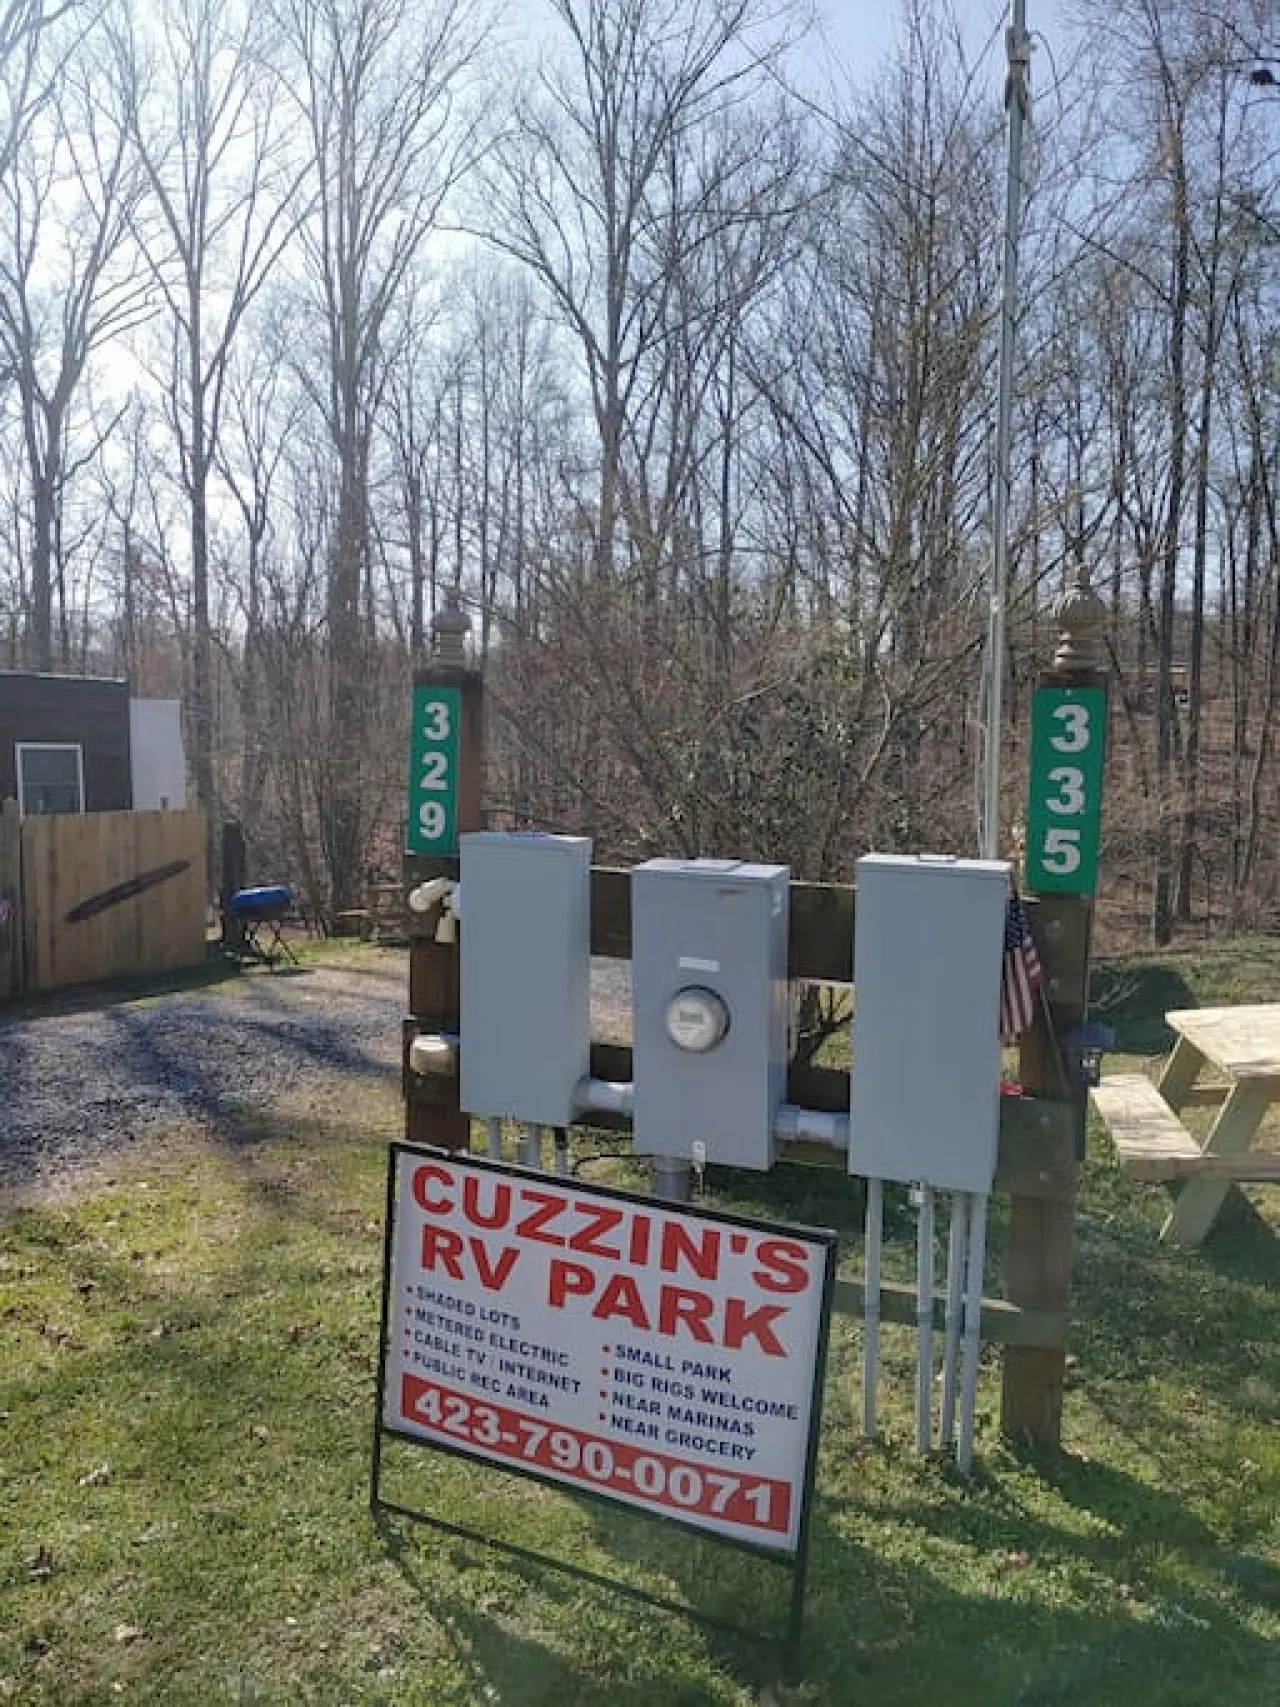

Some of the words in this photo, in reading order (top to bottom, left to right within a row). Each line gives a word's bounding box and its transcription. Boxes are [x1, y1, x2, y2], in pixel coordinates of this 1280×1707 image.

[419, 701, 450, 840] 329
[1040, 703, 1090, 875] 335
[411, 1164, 809, 1294] CUZZIN'S
[416, 1286, 476, 1318] SHADED
[480, 1306, 521, 1330] LOTS
[420, 1224, 520, 1291] RV
[548, 1259, 788, 1357] PARK
[414, 1330, 462, 1360] CABLE
[466, 1348, 486, 1366] TV
[499, 1360, 581, 1395] INTERNET
[415, 1308, 485, 1342] METERED
[489, 1332, 570, 1368] ELECTRIC
[614, 1344, 676, 1372] SMALL
[681, 1360, 732, 1383] PARK
[413, 1350, 467, 1382] PUBLIC
[470, 1371, 501, 1394] REC
[506, 1384, 549, 1409] AREA
[614, 1368, 647, 1390] BIG
[651, 1377, 695, 1401] RIGS
[701, 1386, 798, 1421] WELCOME
[611, 1414, 661, 1438] NEAR
[665, 1423, 756, 1461] GROCERY
[612, 1391, 662, 1416] NEAR
[666, 1405, 756, 1438] MARINAS
[414, 1389, 772, 1523] 423-790-0071
